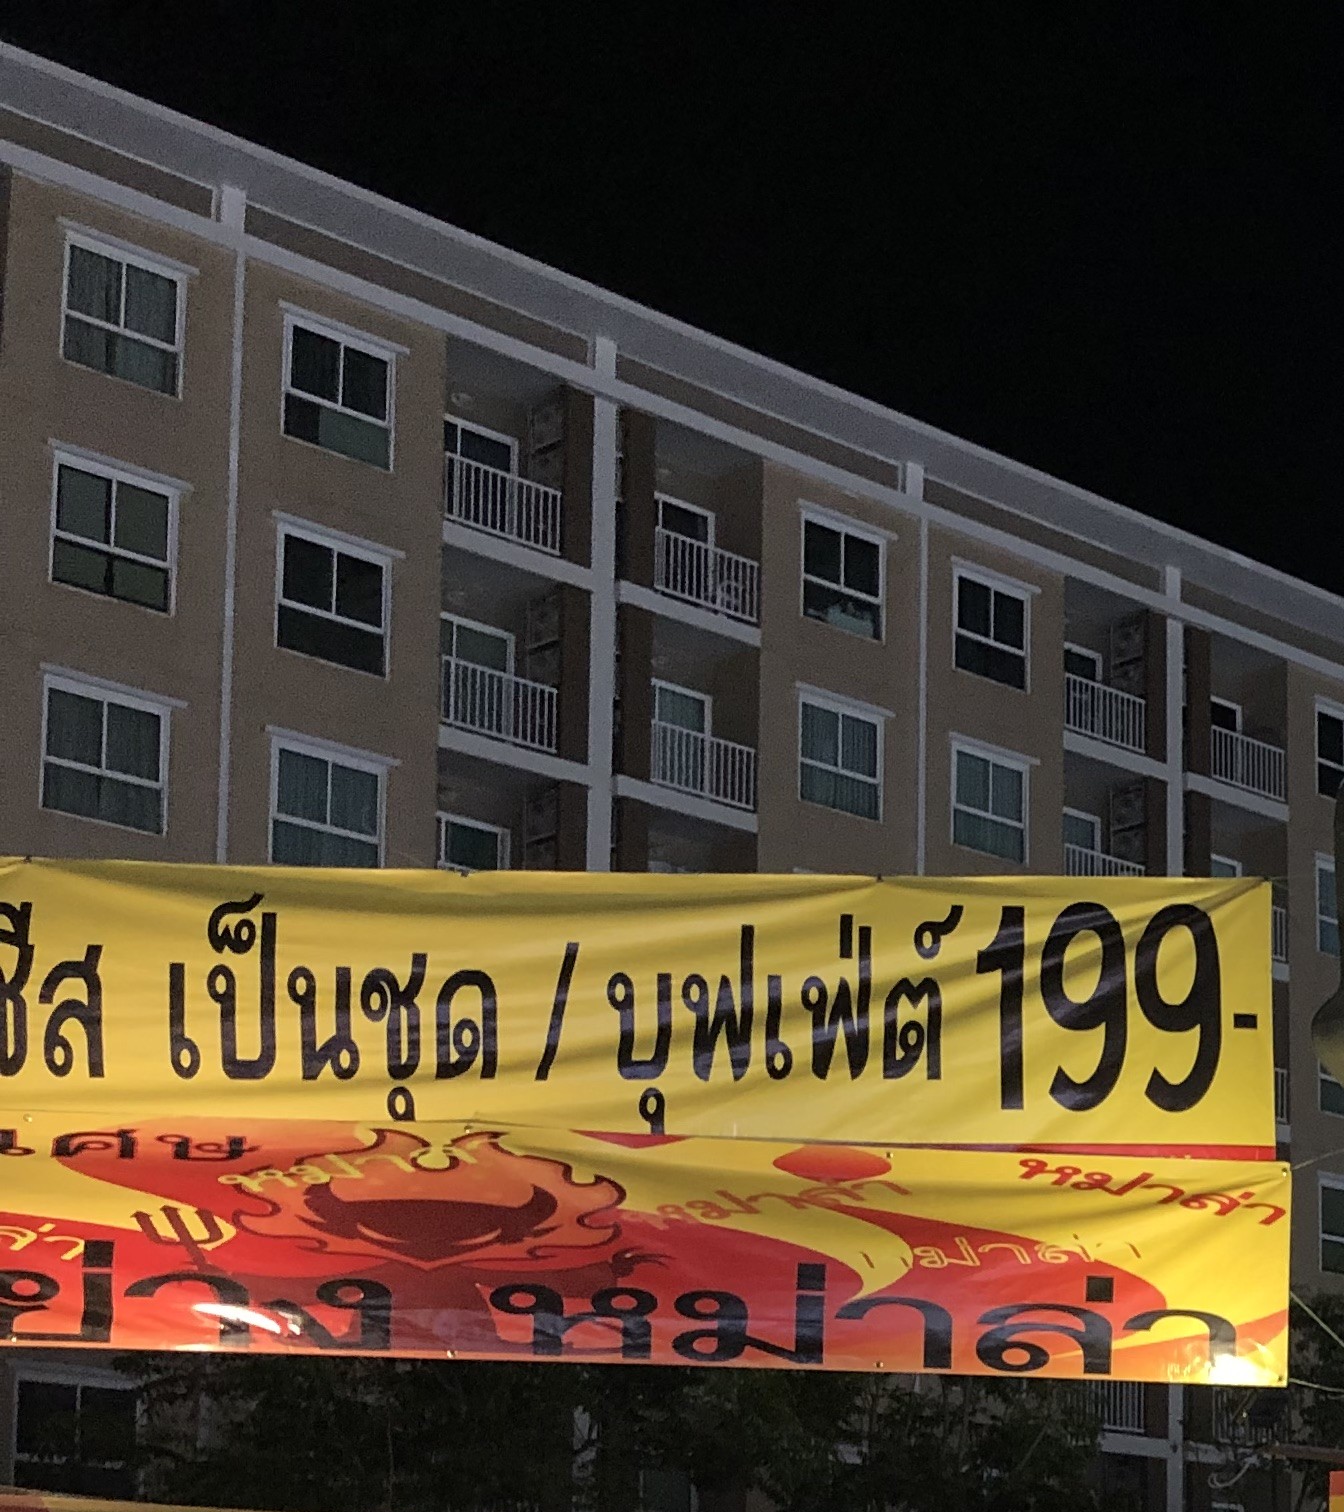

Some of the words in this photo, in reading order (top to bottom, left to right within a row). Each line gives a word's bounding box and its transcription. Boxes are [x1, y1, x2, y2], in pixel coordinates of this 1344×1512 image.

[168, 893, 498, 1122] เป็นชุด
[607, 904, 963, 1135] บุฟเฟ่ต์
[977, 902, 1257, 1113] 199-
